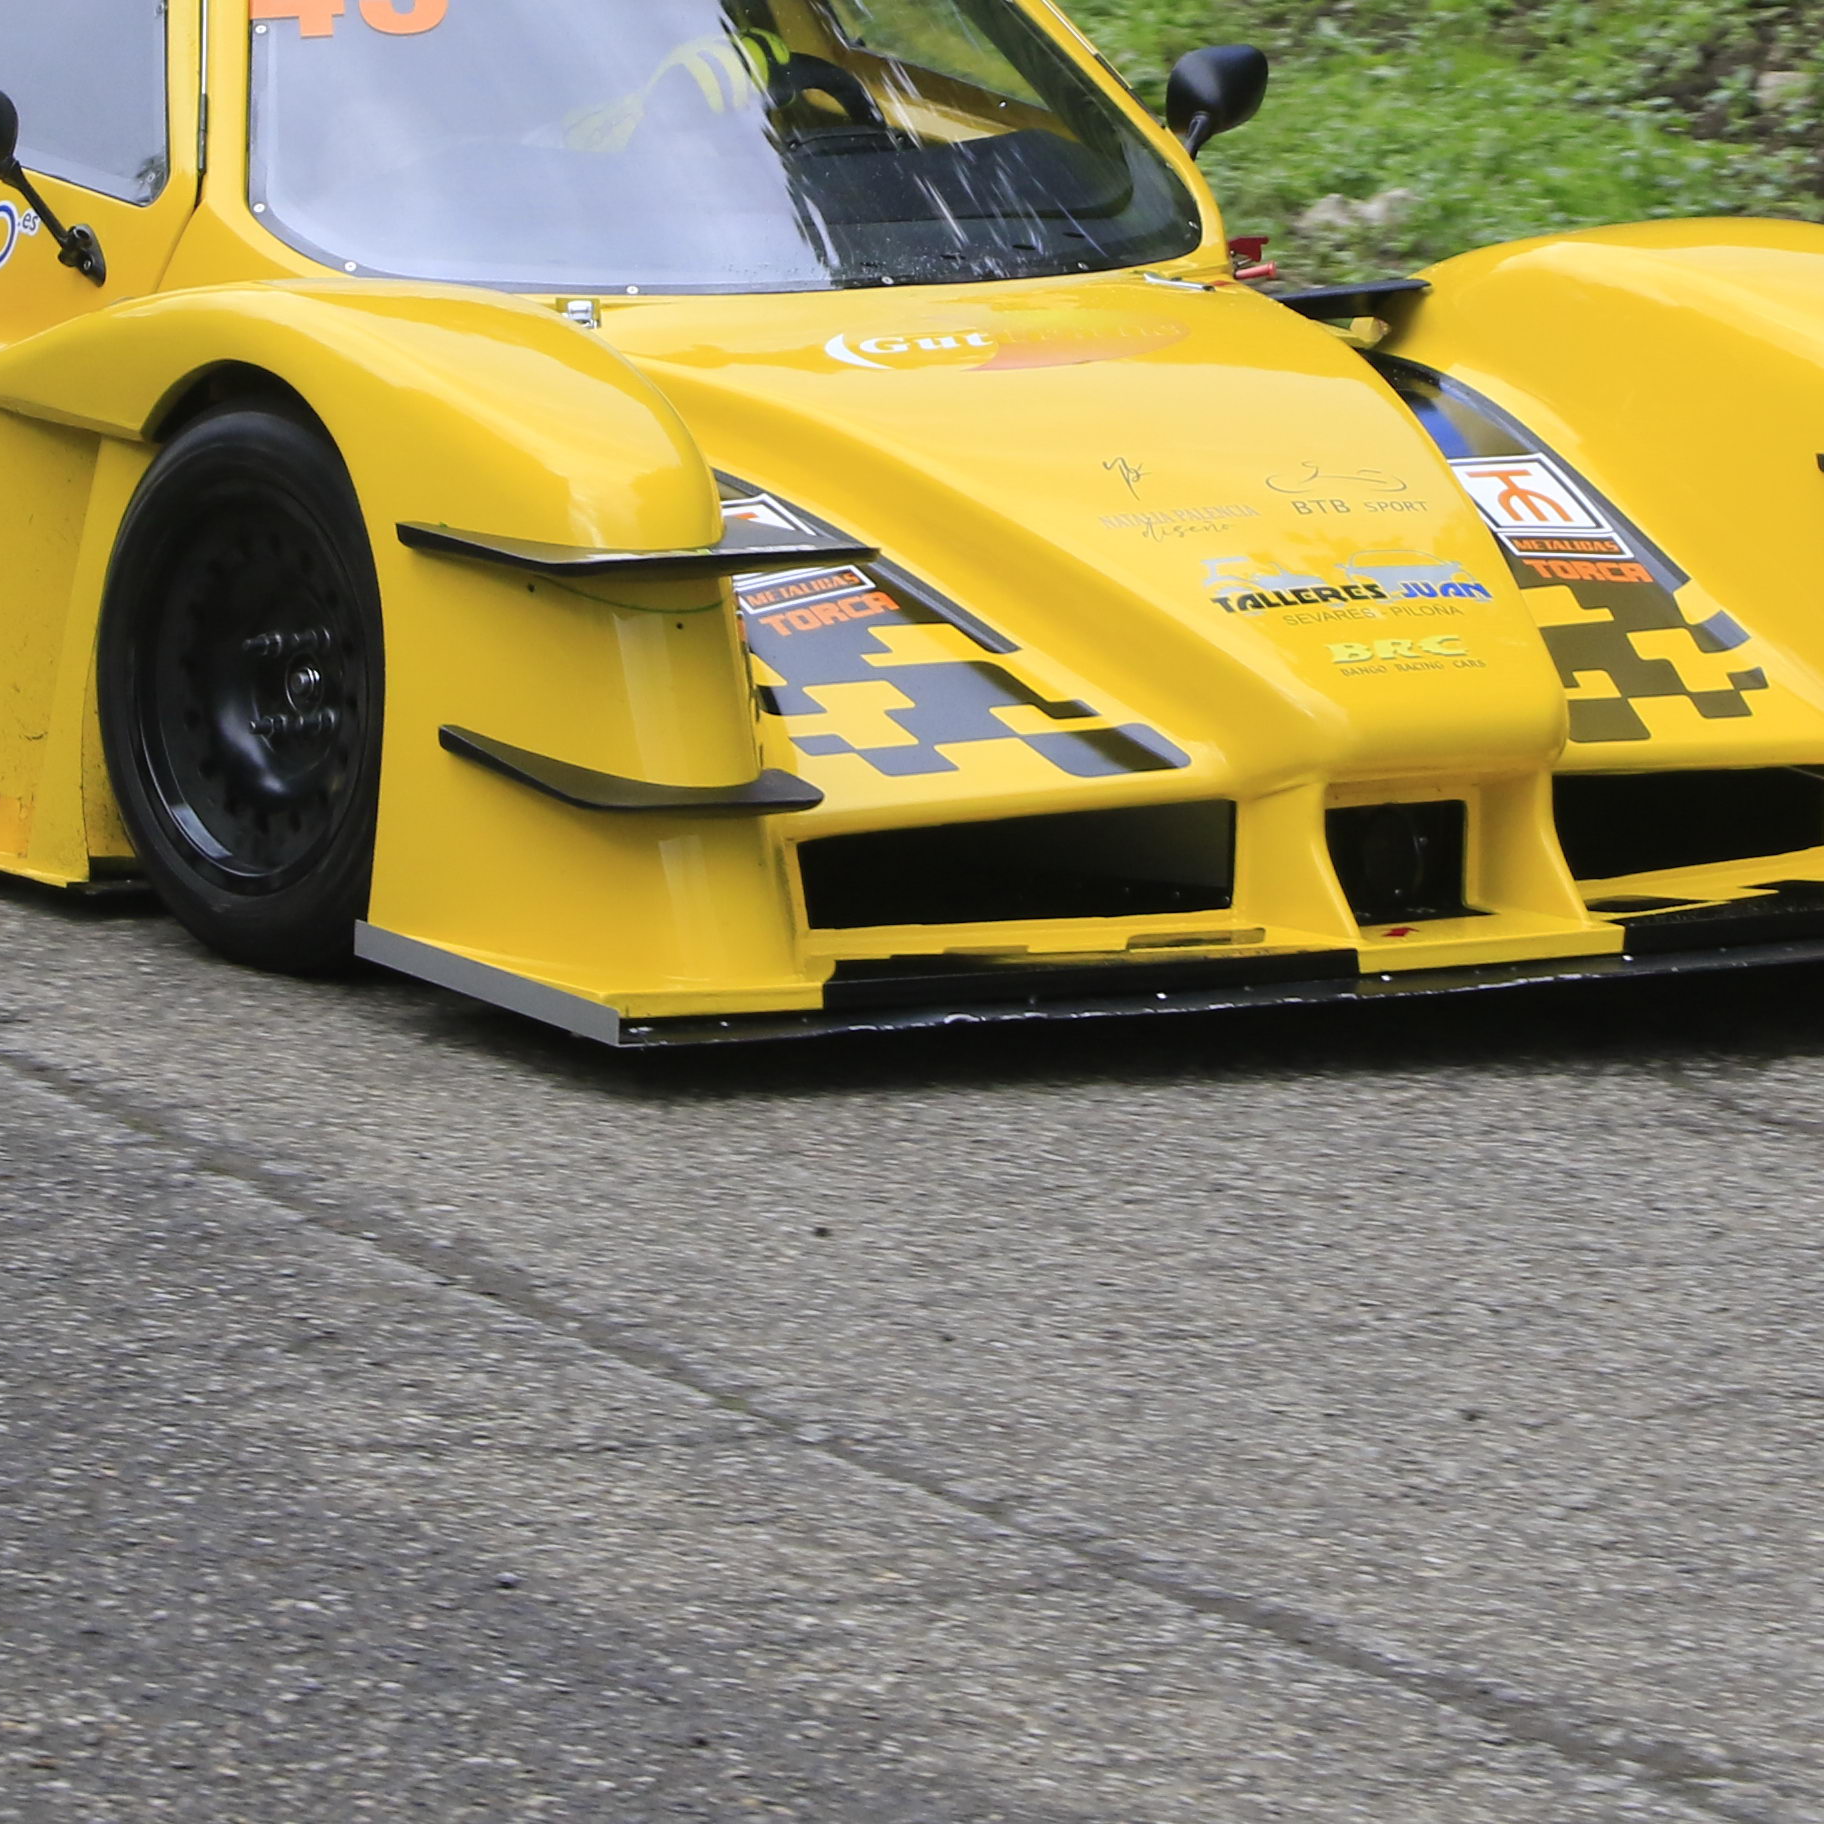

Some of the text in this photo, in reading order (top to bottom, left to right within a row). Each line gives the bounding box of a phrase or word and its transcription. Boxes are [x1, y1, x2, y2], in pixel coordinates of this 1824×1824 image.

[1098, 503, 1261, 530] NATALIA PALENCIA
[1291, 499, 1429, 515] BTB SPORT
[1522, 558, 1655, 583] TORCA
[1210, 581, 1494, 613] TALLERES JUAN
[758, 591, 901, 637] TORCA
[1282, 607, 1377, 627] SEVARES
[1391, 604, 1466, 618] PILOÑA
[1324, 634, 1469, 664] BRC
[1396, 660, 1445, 673] RACING
[1452, 658, 1488, 669] CARS
